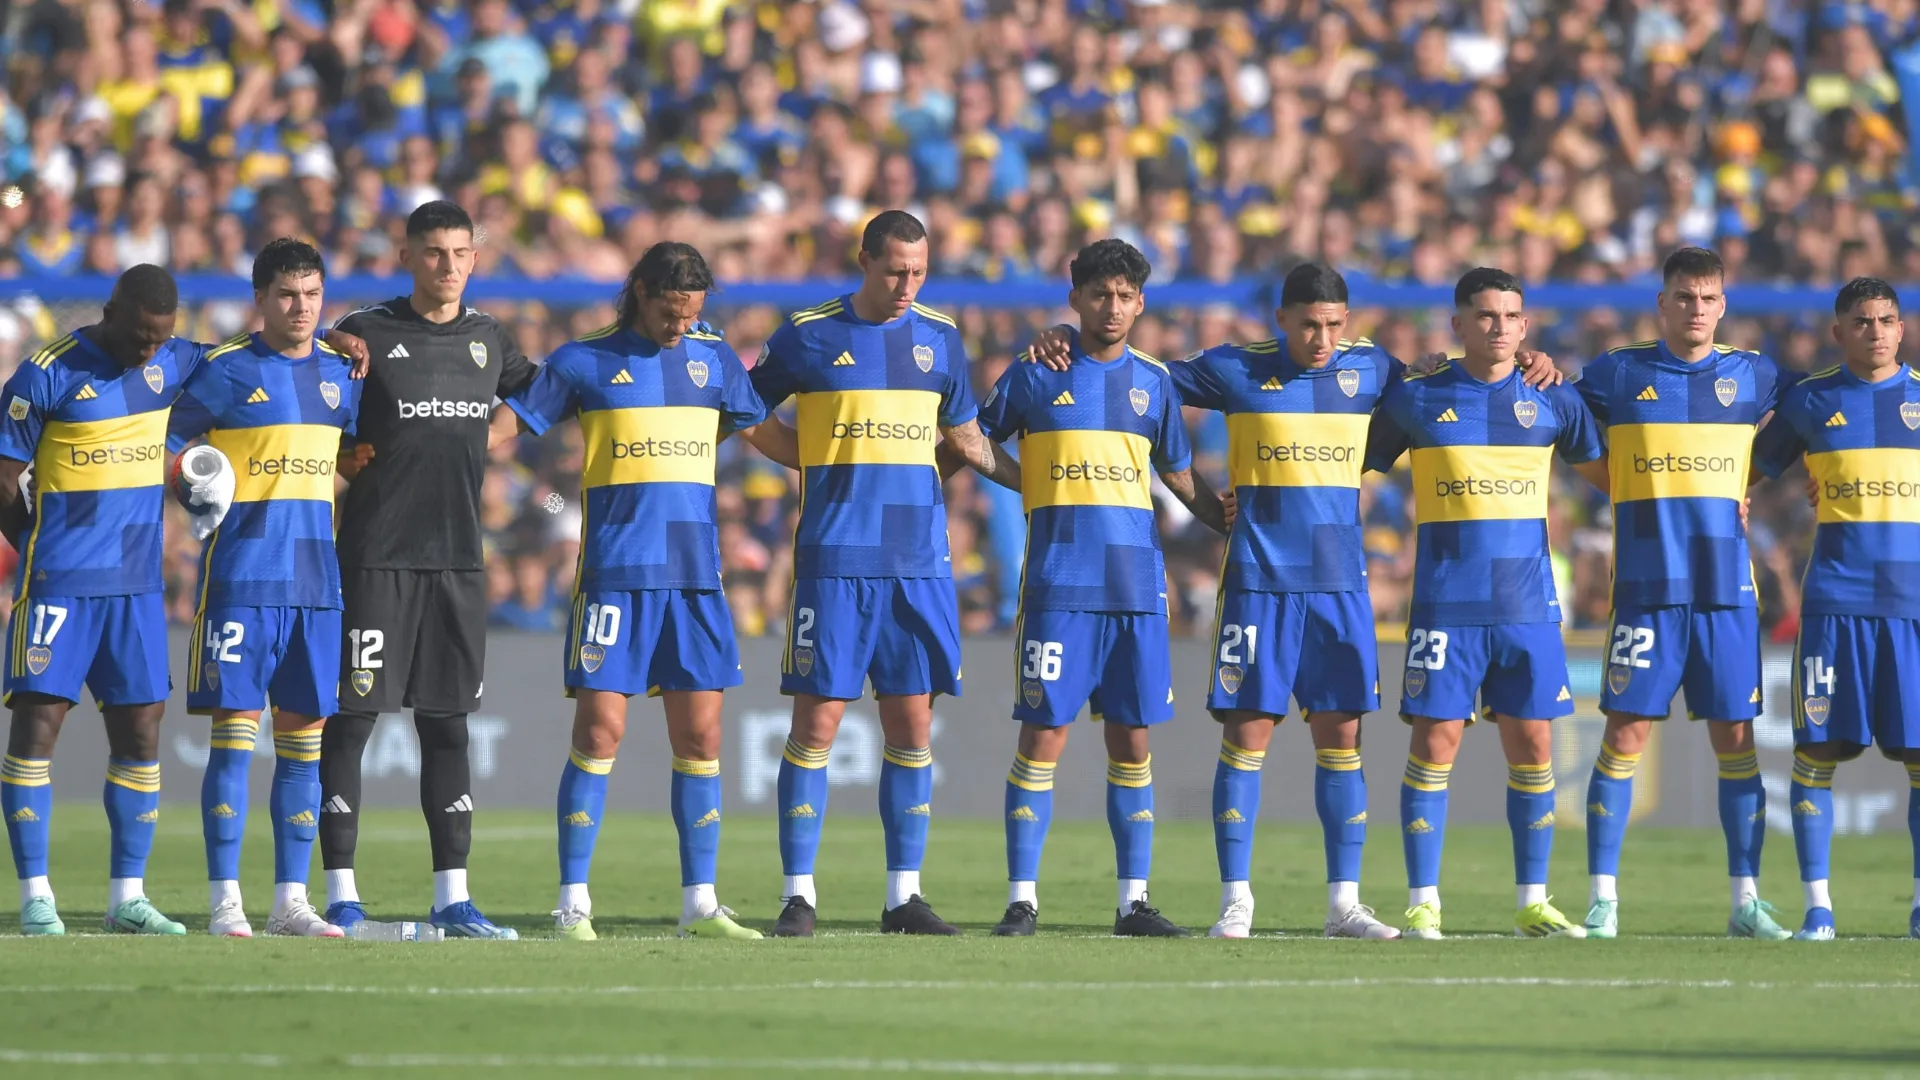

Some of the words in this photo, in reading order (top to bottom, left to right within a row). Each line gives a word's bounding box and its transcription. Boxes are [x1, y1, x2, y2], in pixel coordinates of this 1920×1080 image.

[398, 397, 489, 420] betsson
[612, 437, 711, 460] betsson
[832, 418, 932, 442] betsson
[248, 454, 335, 477] betsson
[1257, 440, 1356, 463] betsson
[1634, 452, 1736, 474] betsson
[1436, 475, 1537, 498] betsson
[33, 604, 68, 646] 17
[206, 619, 245, 664] 42
[587, 603, 622, 646] 10
[797, 607, 815, 648] 2
[1220, 623, 1258, 665] 21
[348, 628, 385, 669] 12
[1024, 639, 1064, 682] 36
[1407, 628, 1449, 671] 23
[1610, 624, 1655, 669] 22
[1804, 656, 1837, 697] 14
